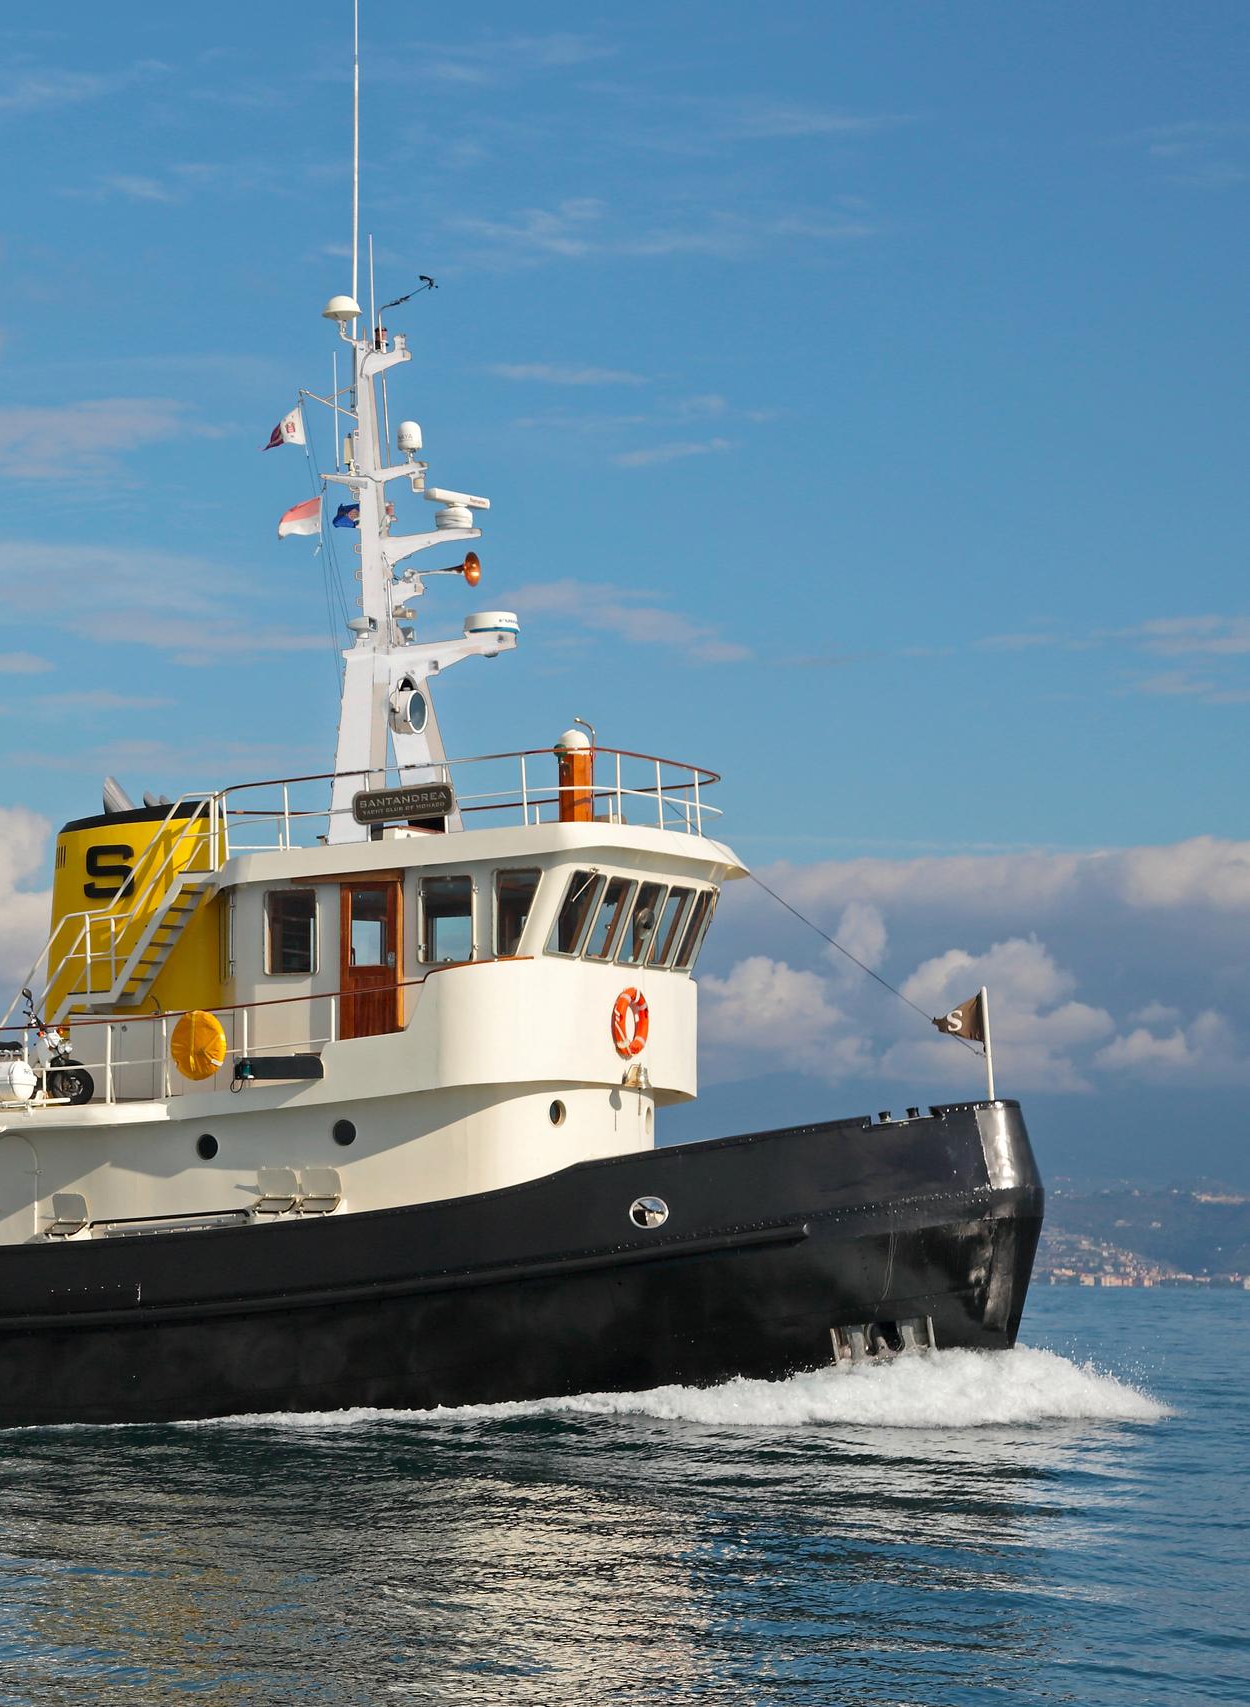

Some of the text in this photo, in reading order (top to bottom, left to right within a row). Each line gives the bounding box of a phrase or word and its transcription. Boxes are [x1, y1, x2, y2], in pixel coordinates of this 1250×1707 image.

[359, 791, 447, 809] SANTANDREA
[416, 802, 445, 810] MONACO
[83, 844, 135, 899] S
[946, 1009, 963, 1032] S
